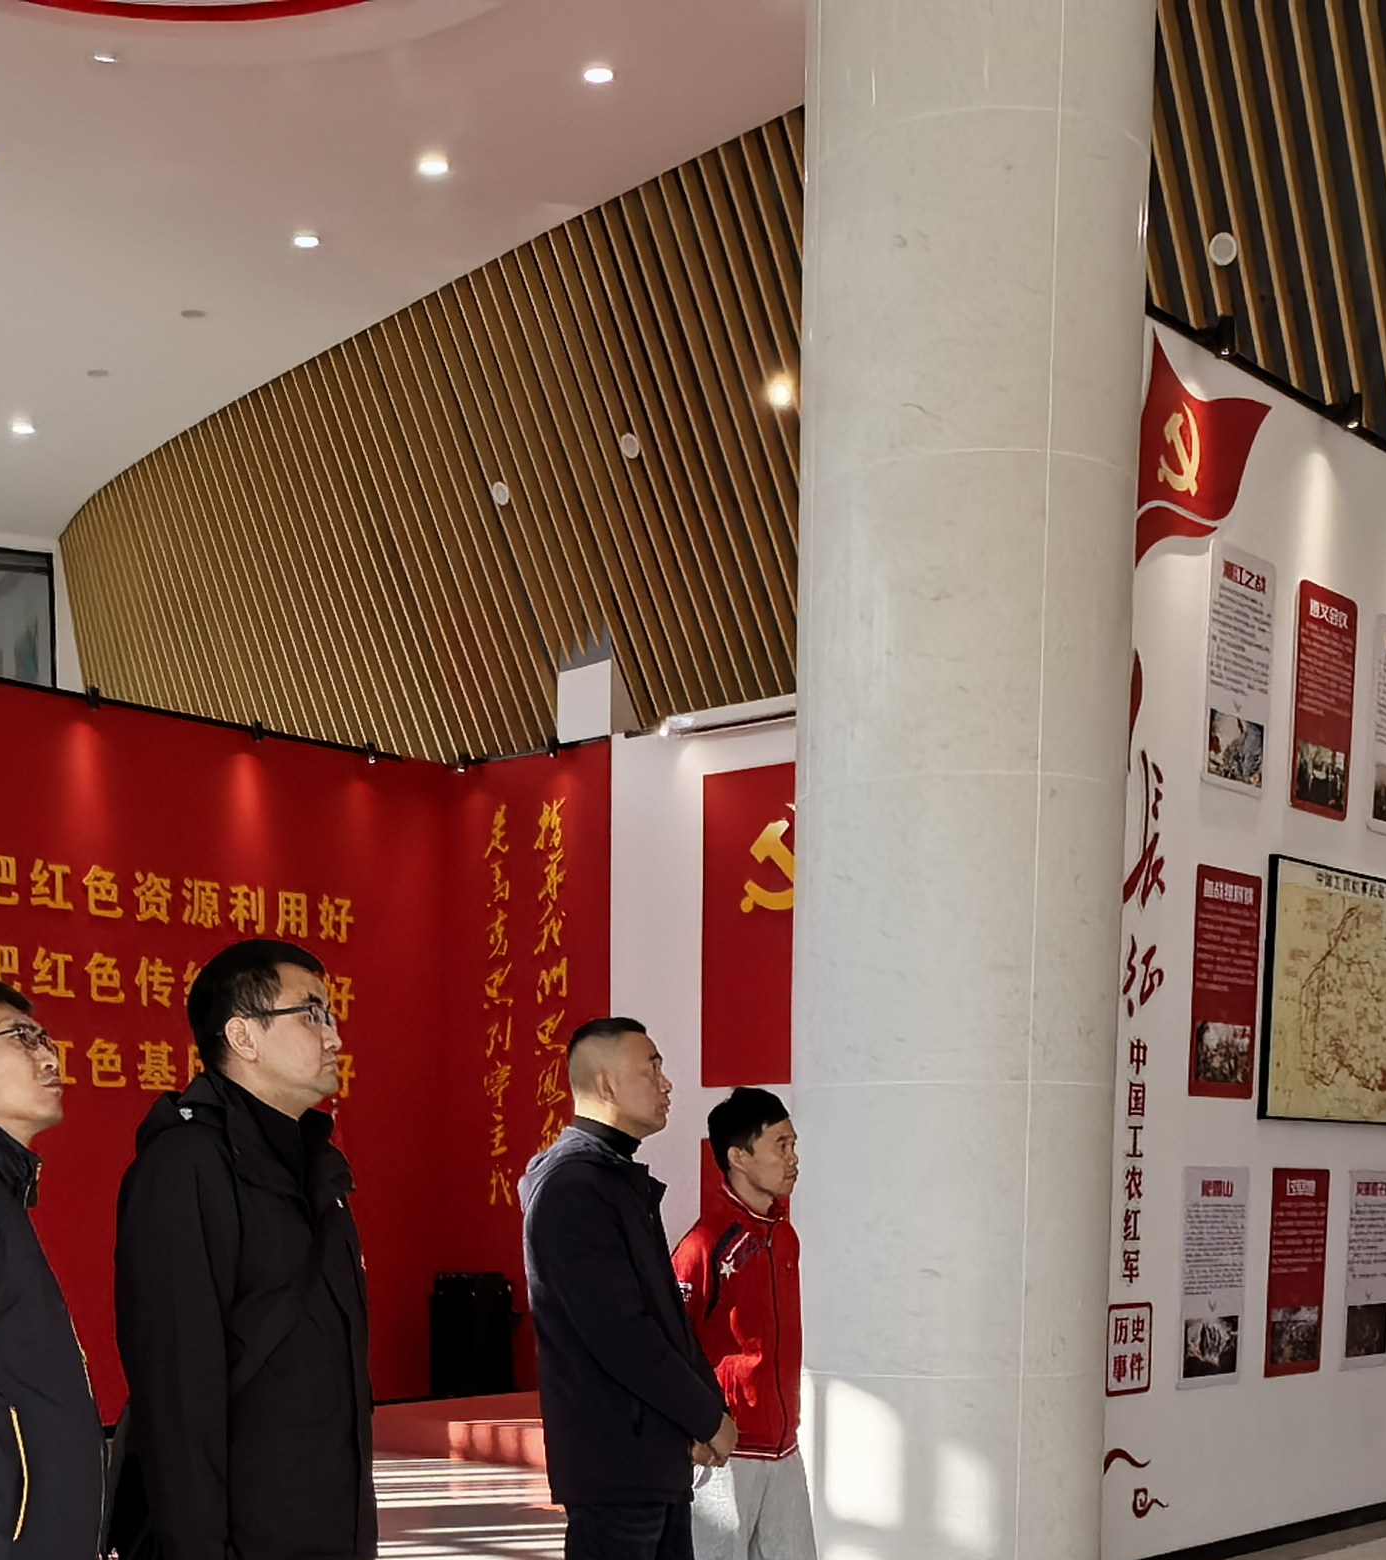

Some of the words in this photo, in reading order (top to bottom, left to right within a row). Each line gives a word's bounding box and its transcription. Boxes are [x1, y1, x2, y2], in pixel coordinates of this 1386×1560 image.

[1122, 1038, 1148, 1284] 中国工农红军
[1113, 1314, 1145, 1345] 历史
[1112, 1352, 1144, 1384] 事件
